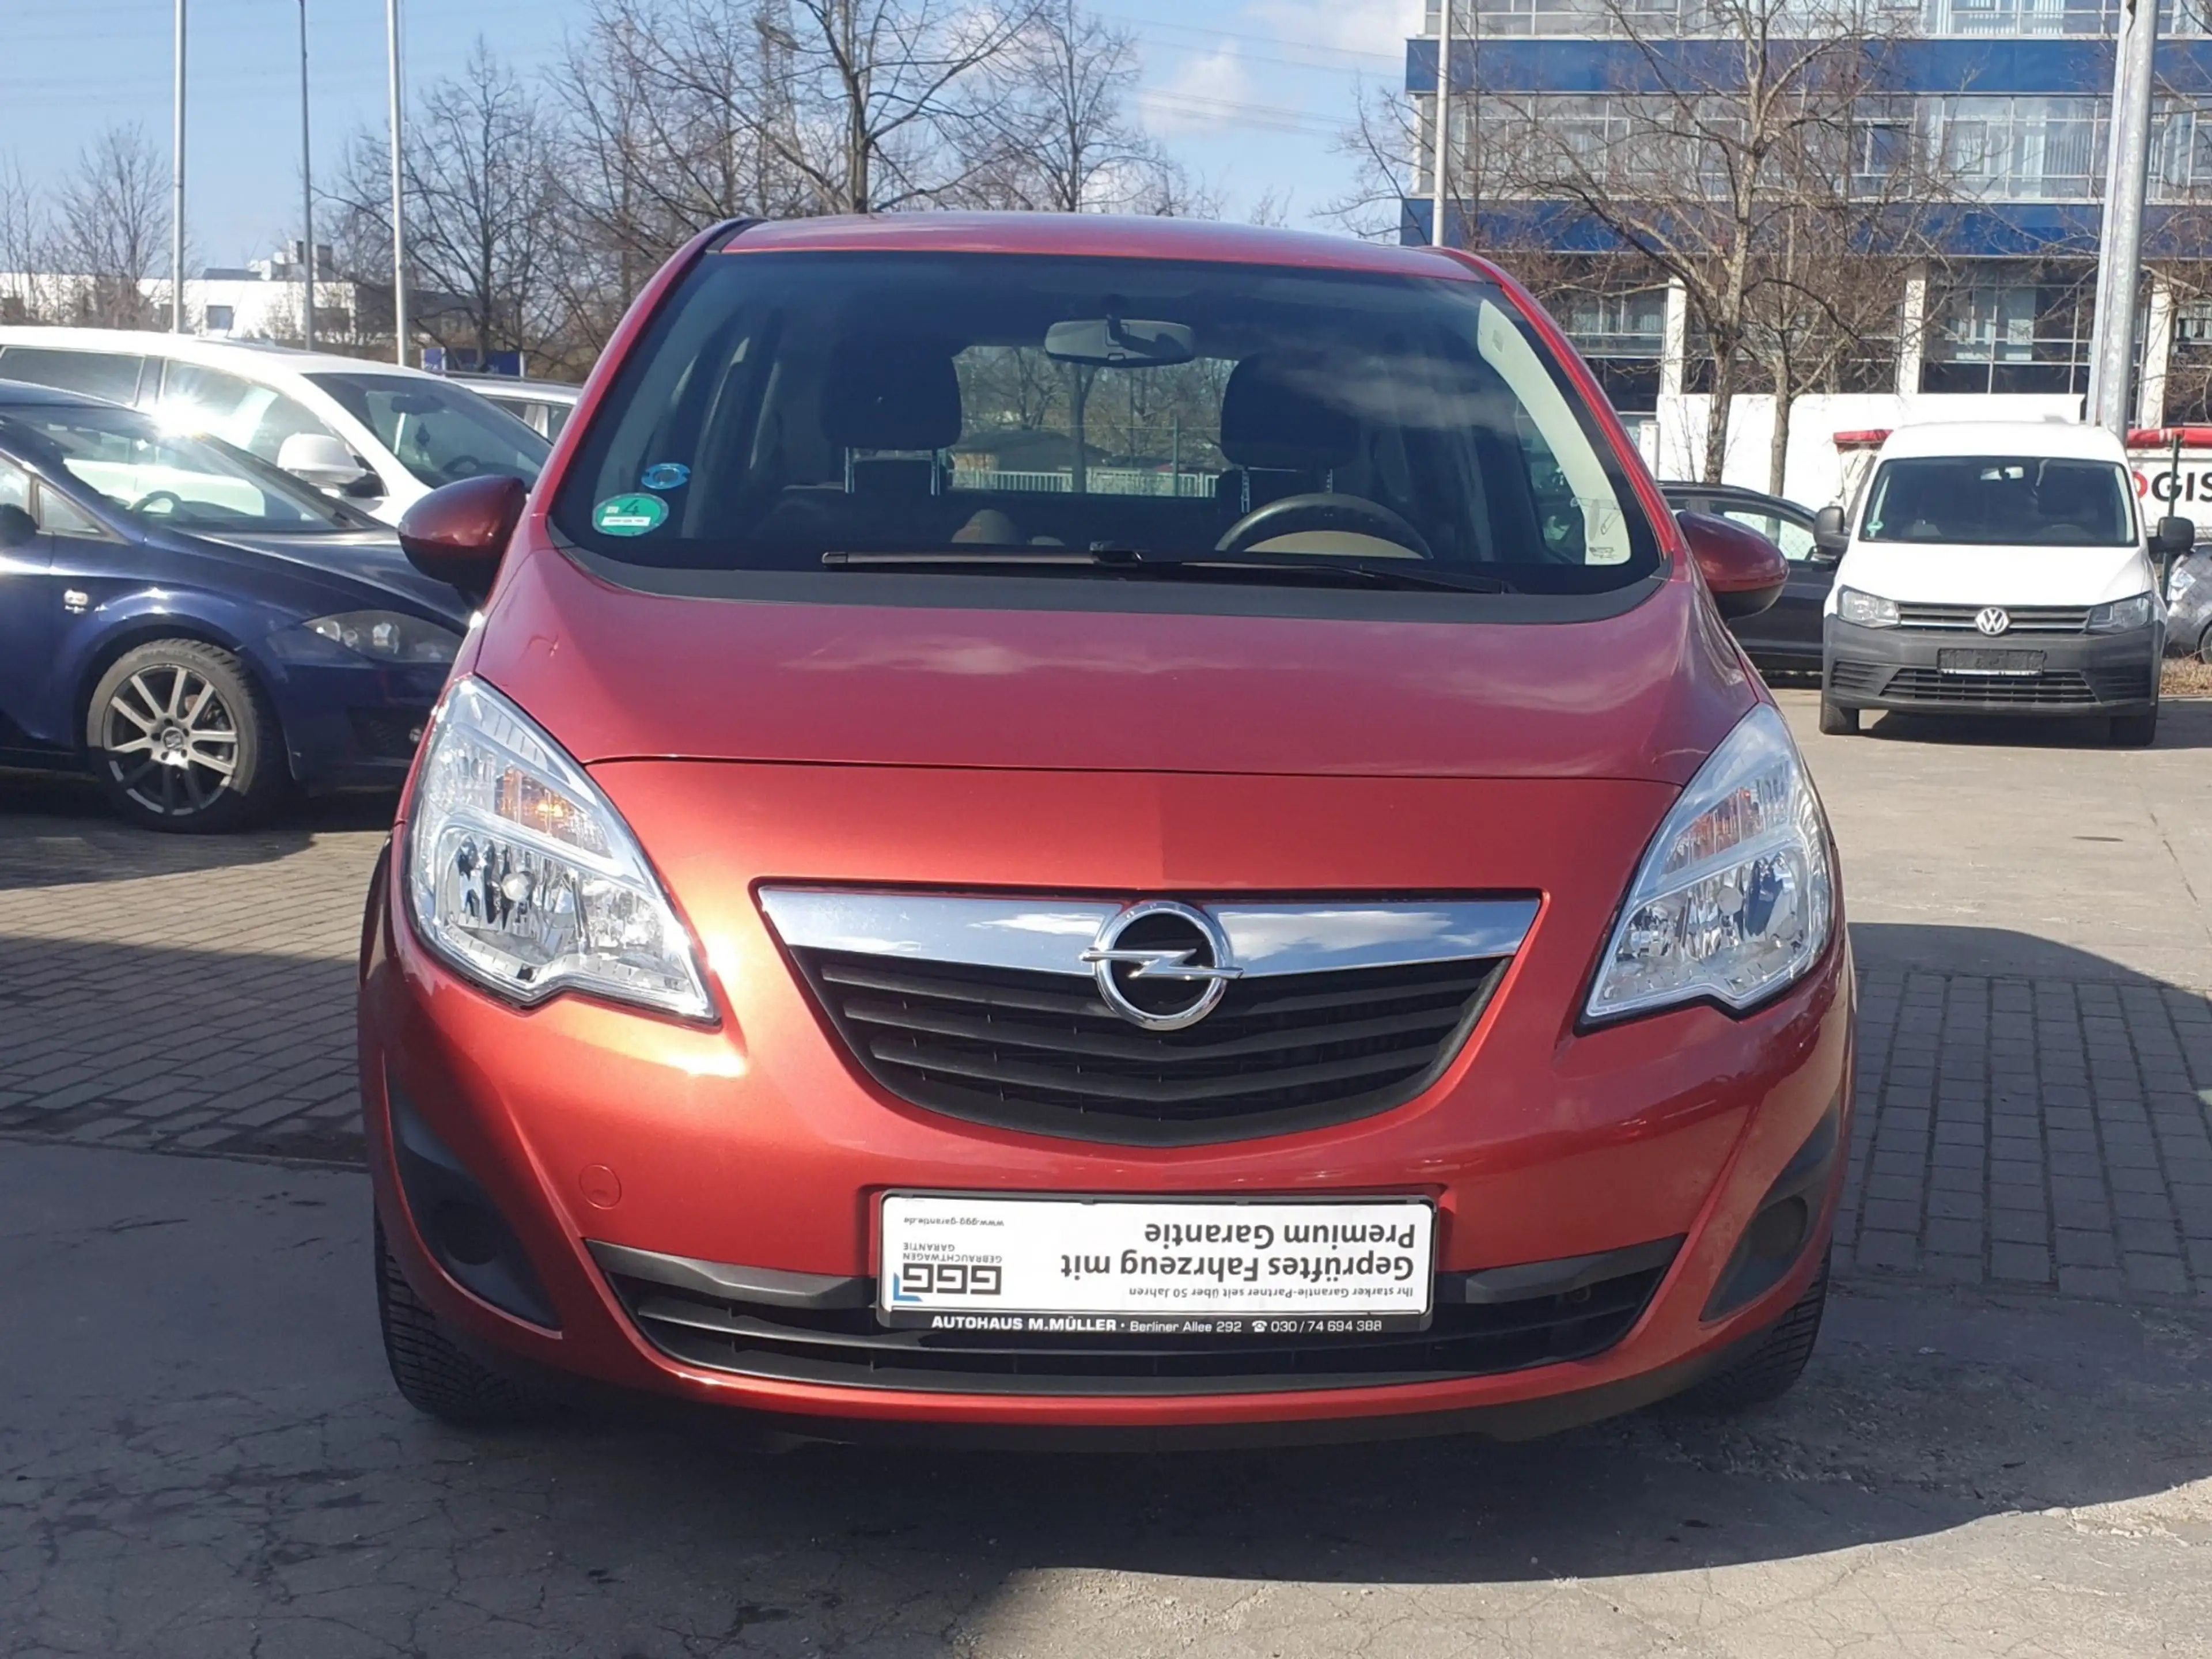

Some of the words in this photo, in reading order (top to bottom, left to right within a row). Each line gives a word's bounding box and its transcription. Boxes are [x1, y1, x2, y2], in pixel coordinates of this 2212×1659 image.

[1145, 1224, 1274, 1250] Garantie
[1283, 1224, 1415, 1249] Premium
[904, 1243, 955, 1252] GARANTIE
[903, 1253, 1002, 1263] GEBRAUCHTWAGEN
[1060, 1255, 1111, 1281] mit
[1120, 1249, 1259, 1282] Fahrzeug
[1268, 1251, 1414, 1283] Geprüftes
[902, 1263, 1002, 1296] GGG
[1129, 1288, 1169, 1298] Jahren
[1173, 1289, 1187, 1298] 50
[1191, 1288, 1219, 1298] über
[1223, 1289, 1244, 1298] seit
[1353, 1287, 1394, 1298] starker
[1397, 1287, 1413, 1297] Ihr
[931, 1315, 1023, 1330] AUTOHAUS
[1029, 1316, 1116, 1331] M.MÜLLER
[1130, 1320, 1179, 1332] Berliner
[1182, 1321, 1212, 1332] Allee
[1216, 1321, 1242, 1332] 292
[1271, 1321, 1297, 1332] 030
[1308, 1320, 1324, 1332] 74
[1327, 1320, 1353, 1332] 694
[1357, 1320, 1382, 1331] 388
